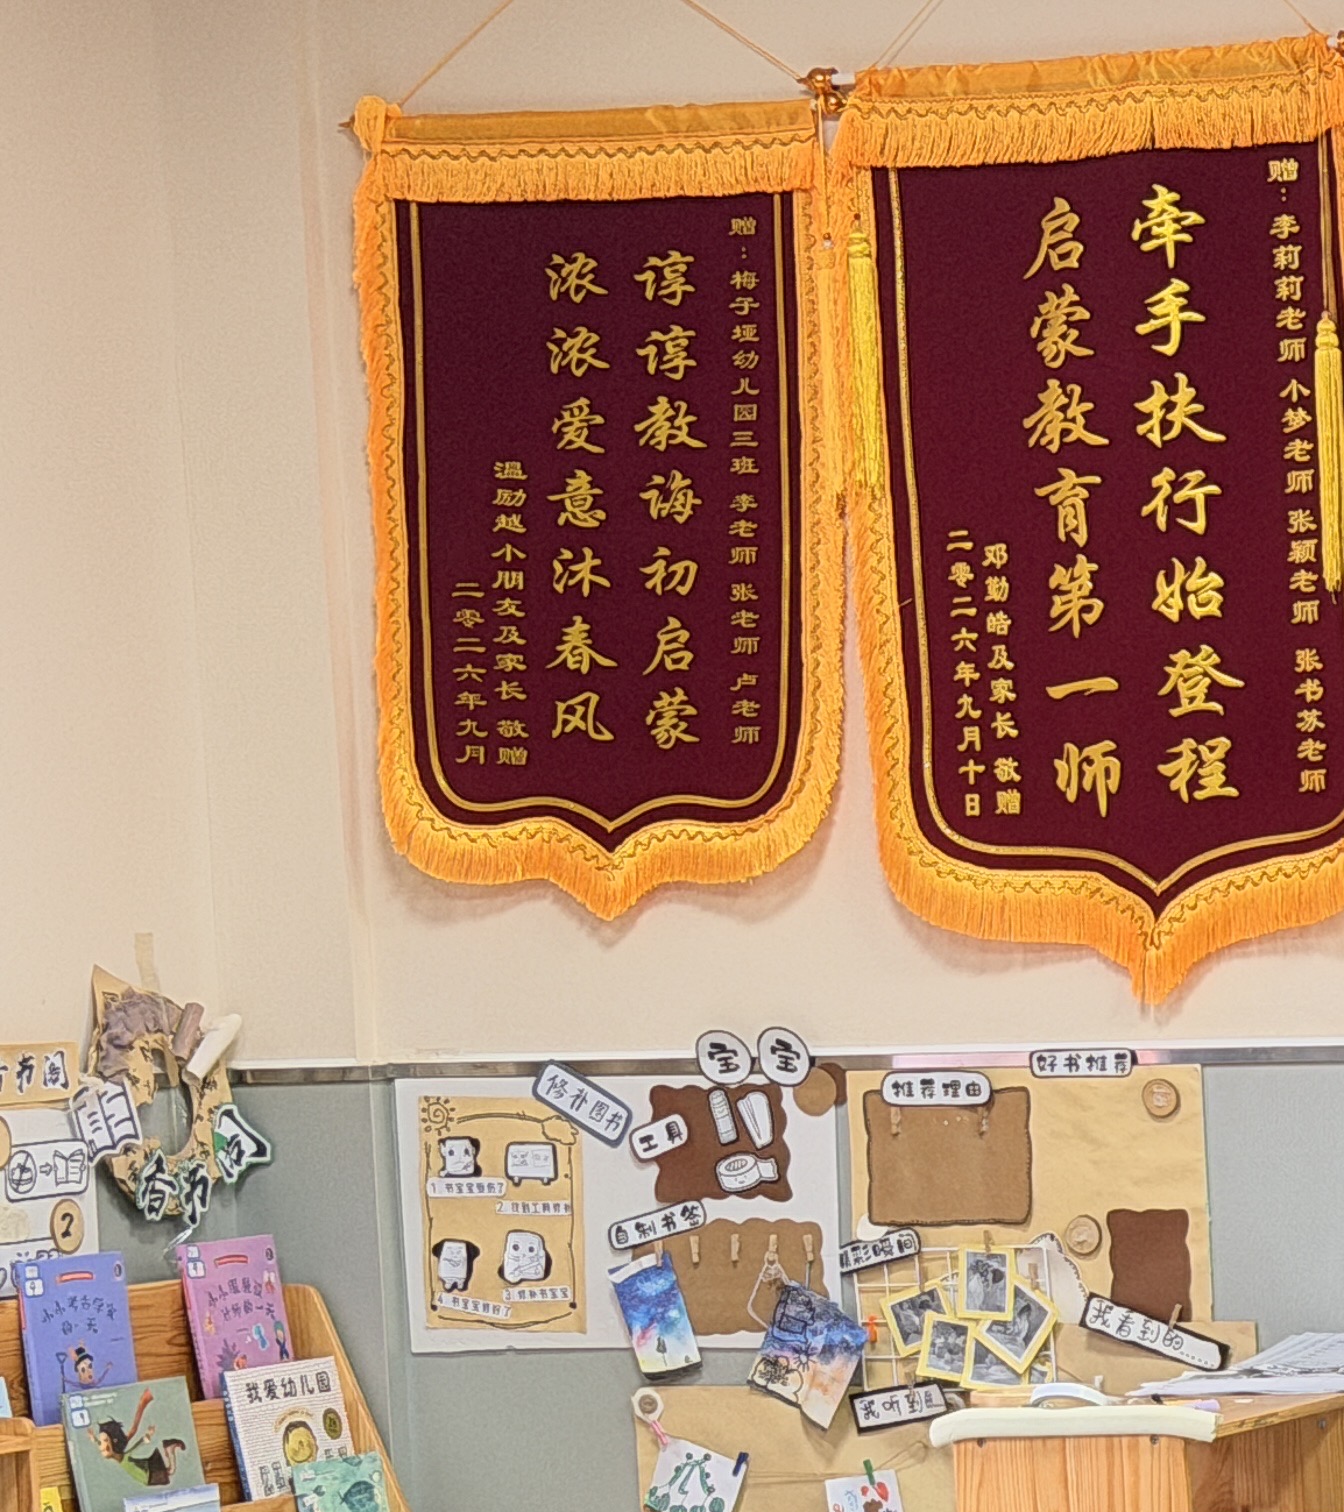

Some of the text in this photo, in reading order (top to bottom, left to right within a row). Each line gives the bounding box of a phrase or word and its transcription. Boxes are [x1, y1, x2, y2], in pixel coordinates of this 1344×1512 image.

[545, 252, 618, 741] 浓浓爱意沐春风
[634, 250, 707, 749] 谆谆教诲初启蒙
[1022, 196, 1121, 818] 启蒙教育第一师
[1131, 183, 1245, 804] 牵手扶行始登程
[1286, 508, 1320, 624] 张颖老师
[730, 583, 760, 655] 张老师
[451, 582, 488, 765] 二零二六年九月
[941, 530, 989, 822] 二零二六年九月十日
[730, 673, 760, 744] 卢老师
[497, 720, 529, 765] 敬赠
[993, 756, 1022, 815] 敬赠
[708, 1039, 801, 1075] 宝 宝
[1037, 1052, 1128, 1074] 好书推荐
[545, 1074, 623, 1134] 修补图书
[892, 1078, 982, 1099] 推荐理由
[639, 1120, 684, 1153] 工具
[60, 1212, 75, 1240] 2
[615, 1206, 702, 1244] 自制书签
[246, 1372, 332, 1403] 我爱幼儿园
